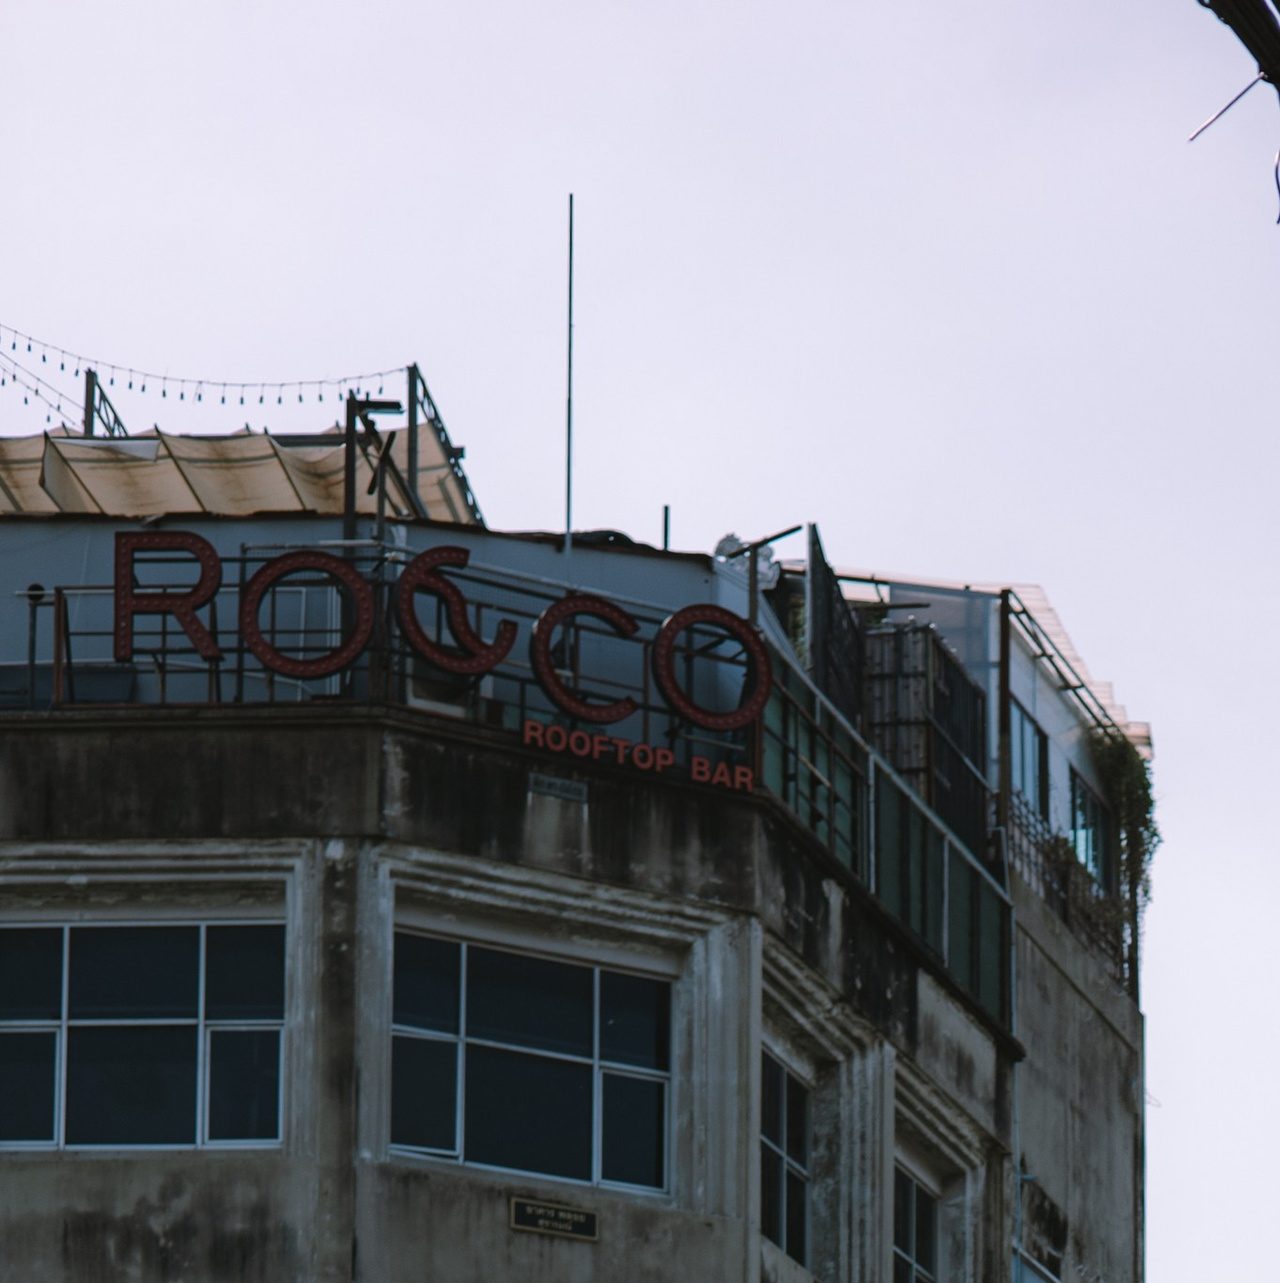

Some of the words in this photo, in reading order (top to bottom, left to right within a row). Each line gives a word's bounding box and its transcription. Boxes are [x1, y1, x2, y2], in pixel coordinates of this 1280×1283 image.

[115, 531, 772, 731] ROCCO
[523, 720, 675, 773] ROOFTOP
[691, 756, 755, 792] BAR
